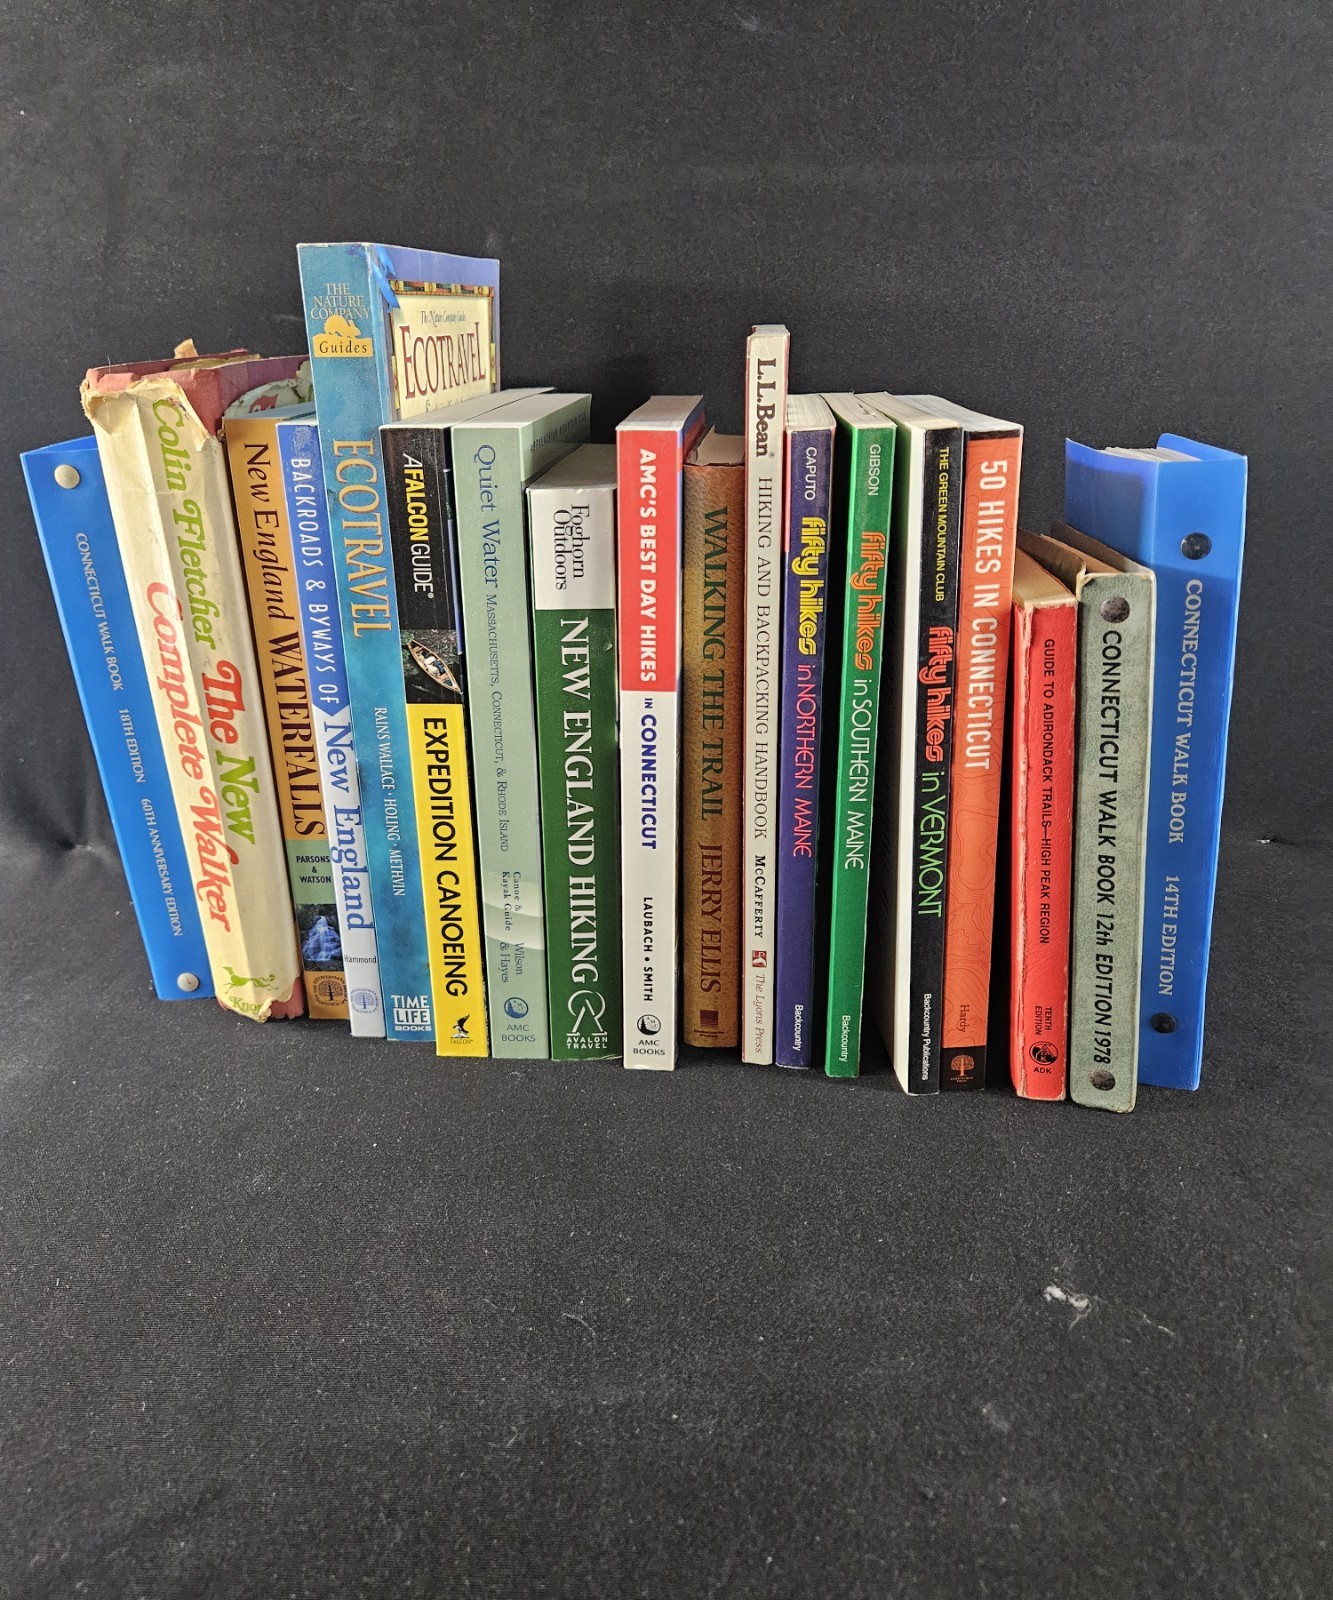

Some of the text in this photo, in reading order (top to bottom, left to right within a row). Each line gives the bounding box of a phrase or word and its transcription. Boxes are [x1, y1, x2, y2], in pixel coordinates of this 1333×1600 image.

[310, 308, 370, 320] COMPANY
[313, 296, 365, 308] NATURE
[324, 283, 350, 295] THE
[319, 340, 367, 354] Guides
[399, 321, 487, 399] ECOTRAVEL
[474, 444, 498, 512] Quiet
[804, 447, 817, 500] CAPUTO
[868, 444, 881, 496] GIBSON
[152, 398, 221, 651] Colin Fletcher
[332, 438, 393, 638] ECOTRAVEL
[553, 509, 572, 590] Outdoors
[565, 503, 590, 579] Foghorn
[758, 477, 772, 549] HIKING
[935, 447, 949, 602] THE GREEN MOUNTAIN CLUB
[290, 458, 340, 705] BACKROADS & BYWAYS OF
[482, 519, 501, 588] Water
[640, 448, 657, 682] AMC'S BEST DAY HIKES
[758, 556, 771, 597] AND
[75, 532, 125, 692] CONNECTICUT WALK BOOK
[243, 442, 326, 836] New England WATERFALLS
[965, 460, 1008, 770] 50 HIKES IN CONNECTICUT
[701, 506, 728, 821] WALKING THE TRAIL
[755, 605, 770, 735] BACKPACKING
[791, 516, 826, 858] fifty hikes in NORTHERN MAINE
[1044, 639, 1055, 677] GUIDE
[1044, 681, 1055, 699] TO
[844, 531, 886, 870] fifty hikes in SOUTHERN MAINE
[1168, 579, 1203, 844] CONNECTICUT WALK BOOK
[118, 708, 147, 783] 18TH EDITION
[146, 581, 240, 933] Complete Walker
[201, 659, 260, 846] The New
[496, 767, 506, 777] &
[641, 698, 657, 850] IN CONNECTICUT
[918, 626, 954, 917] fifty hikes in VERMONT
[1042, 703, 1054, 783] ADIRONDACK
[323, 721, 375, 931] New England
[374, 707, 406, 897] RAINS WALLACE HOLING METHVIN
[560, 617, 598, 983] NEW ENGLAND HIKING
[754, 742, 769, 839] HANDBOOK
[140, 798, 184, 937] 60TH ANNIVERSARY EDITION
[296, 855, 331, 864] PARSONS
[299, 875, 332, 884] WATSON
[311, 866, 318, 874] &
[423, 717, 468, 997] EXPEDITION CANOEING
[512, 871, 521, 901] Canoe
[1040, 870, 1051, 899] PEAK
[1094, 630, 1122, 1065] CONNECTICUT WALK BOOK 12th EDITION 1978
[500, 871, 513, 931] Kayak Guide
[698, 843, 723, 993] JERRY ELLIS
[1040, 903, 1050, 944] REGION
[1158, 875, 1180, 996] 14TH EDITION
[344, 955, 377, 963] Hammond
[499, 942, 511, 983] & Hayes
[514, 942, 524, 975] Wilson
[643, 897, 653, 1001] LAUBACH SMITH
[391, 995, 429, 1008] TIME
[396, 1010, 429, 1023] LIFE
[501, 1034, 536, 1042] BOOKS
[753, 974, 765, 1053] The Lyons Press
[792, 1004, 803, 1052] Backcountry
[838, 1015, 851, 1063] Backcountry
[921, 993, 932, 1081] Backcountry Publications
[957, 1004, 970, 1033] Hardy
